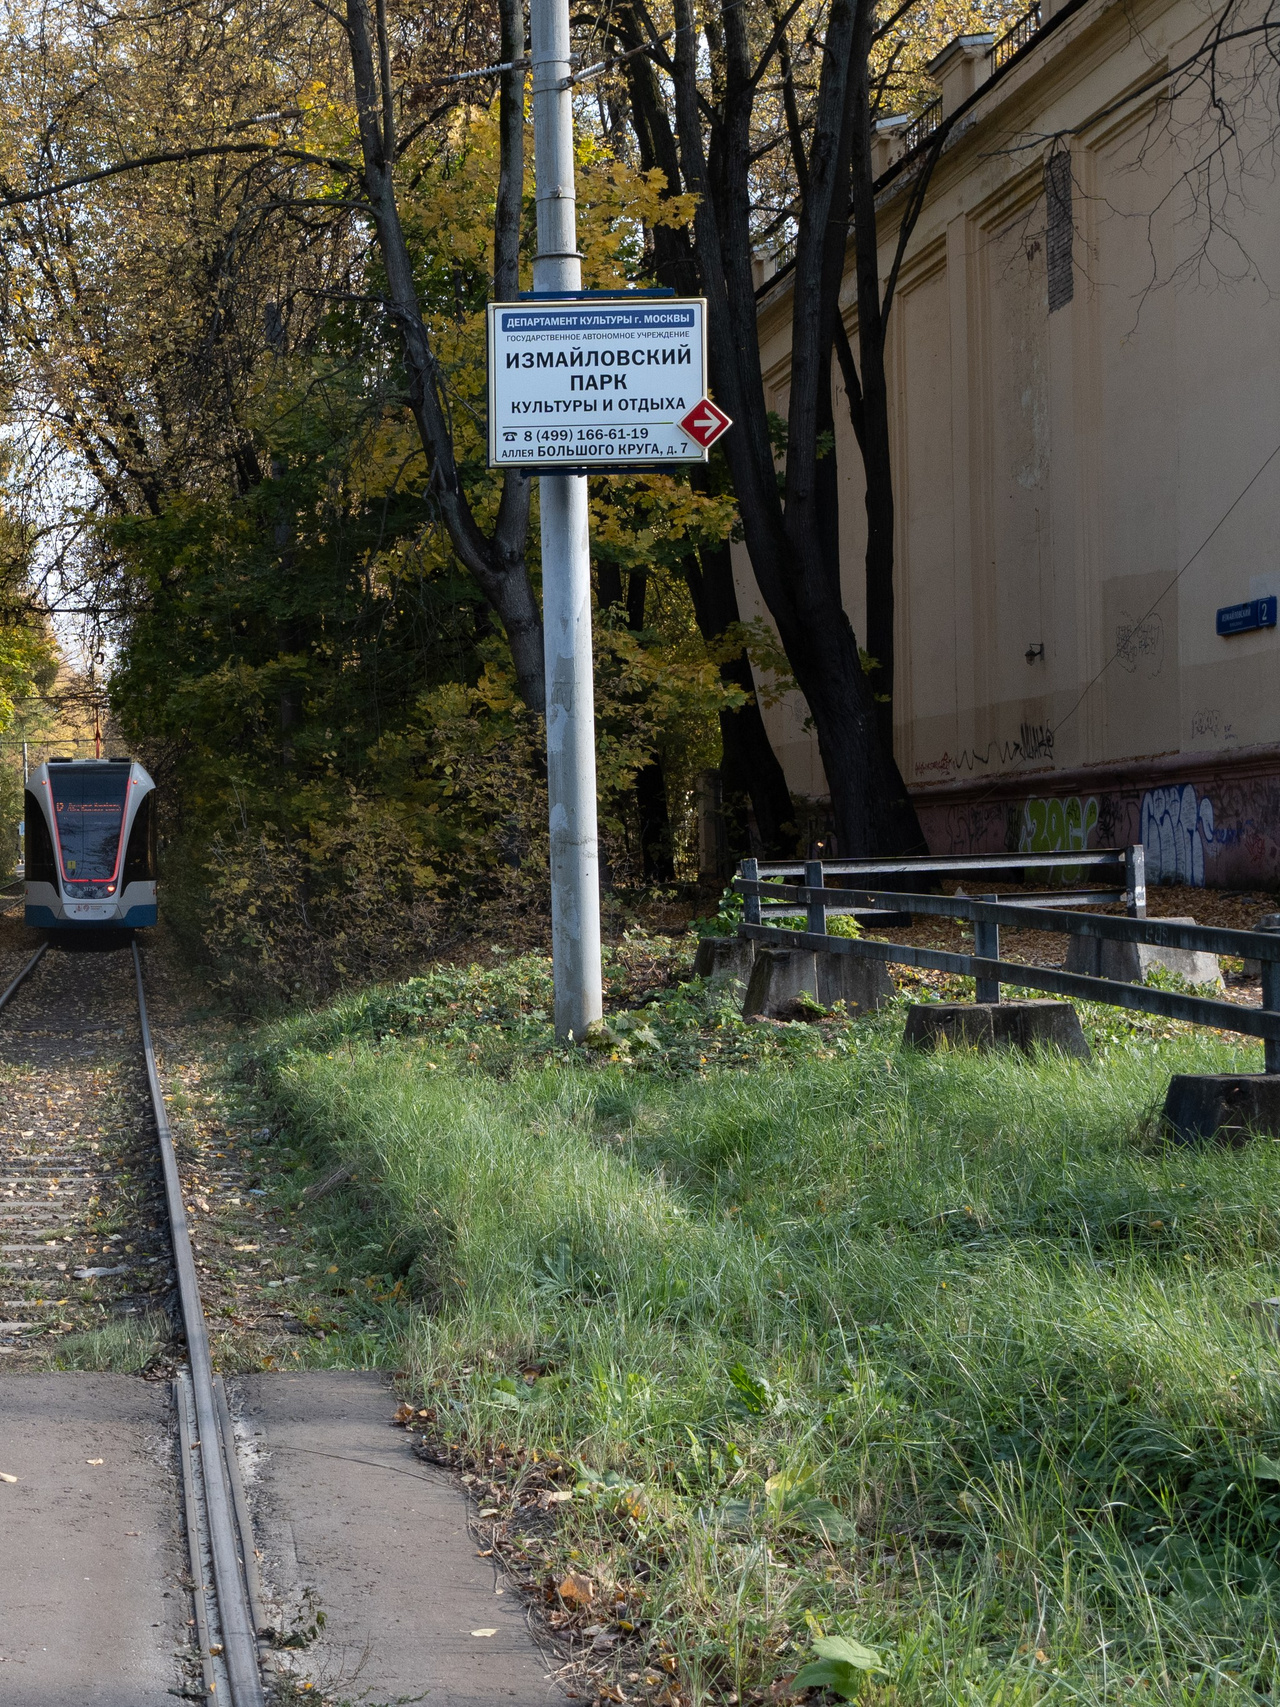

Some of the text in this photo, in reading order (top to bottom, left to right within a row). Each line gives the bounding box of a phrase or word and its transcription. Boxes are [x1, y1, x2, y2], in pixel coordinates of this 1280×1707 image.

[506, 316, 578, 328] ДЕПАРТАМЕНТ
[579, 315, 632, 325] КУЛЬТУРЫ
[644, 314, 690, 323] МОСКВЫ
[506, 331, 689, 342] ГОСУДАРСТВЕННОЕ АВТОНОМНОЕ УЧРЕЖДЕНИЕ
[506, 344, 691, 369] ИЗМАЙЛОВСКИЙ
[570, 374, 628, 391] ПАРК
[511, 397, 686, 414] КУЛЬТУРЫ И ОТДЫХА
[524, 428, 649, 442] 8 (499) 166-61-19
[502, 442, 688, 458] АЛЛЕЯ БОЛЬШОГО КРУГА, д. 7
[1262, 603, 1267, 620] 2
